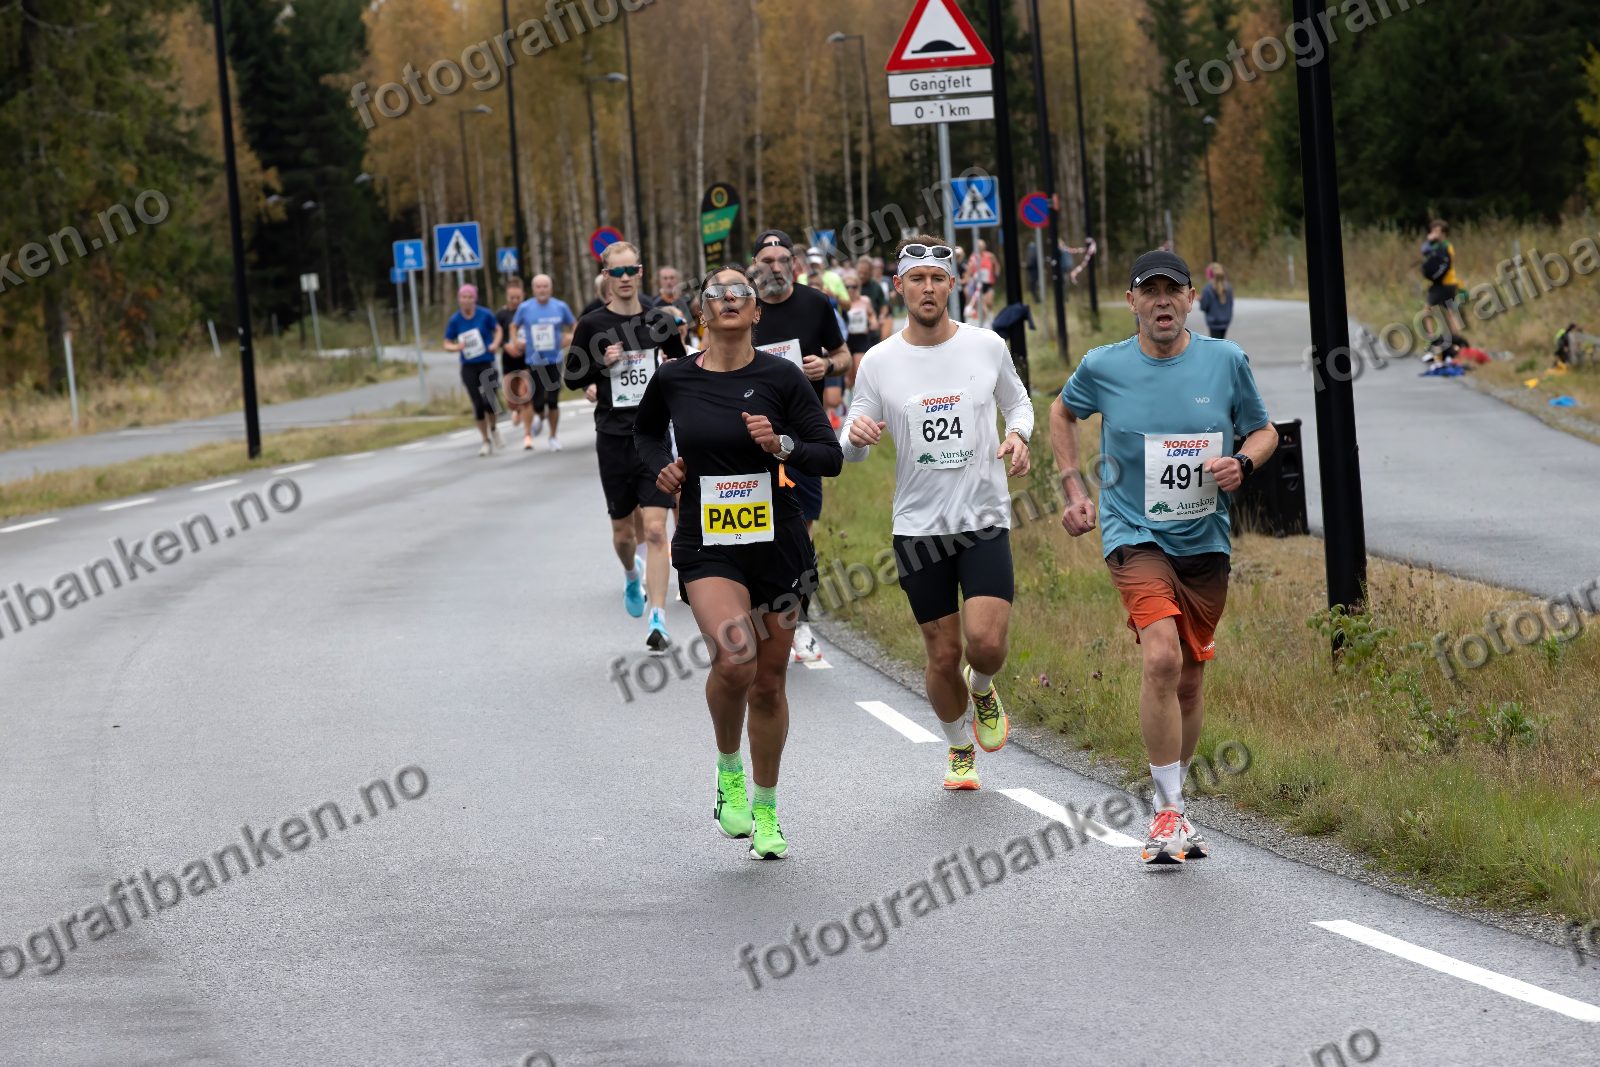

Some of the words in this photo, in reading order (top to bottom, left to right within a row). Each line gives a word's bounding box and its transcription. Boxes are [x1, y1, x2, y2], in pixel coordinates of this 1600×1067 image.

[910, 75, 972, 92] Gangfelt
[914, 106, 924, 119] 0
[940, 105, 945, 117] 1
[949, 104, 970, 117] km
[620, 368, 647, 386] 565
[921, 395, 961, 406] NORGES
[925, 403, 956, 413] LØPET
[922, 416, 963, 442] 624
[1163, 439, 1210, 449] NORGES
[940, 449, 974, 460] Aurskog
[1166, 448, 1202, 457] LØPET
[1160, 463, 1204, 490] 491
[716, 480, 759, 490] NORGES
[718, 488, 753, 499] LØPET
[1176, 496, 1216, 511] Aurskog
[708, 505, 767, 530] PACE
